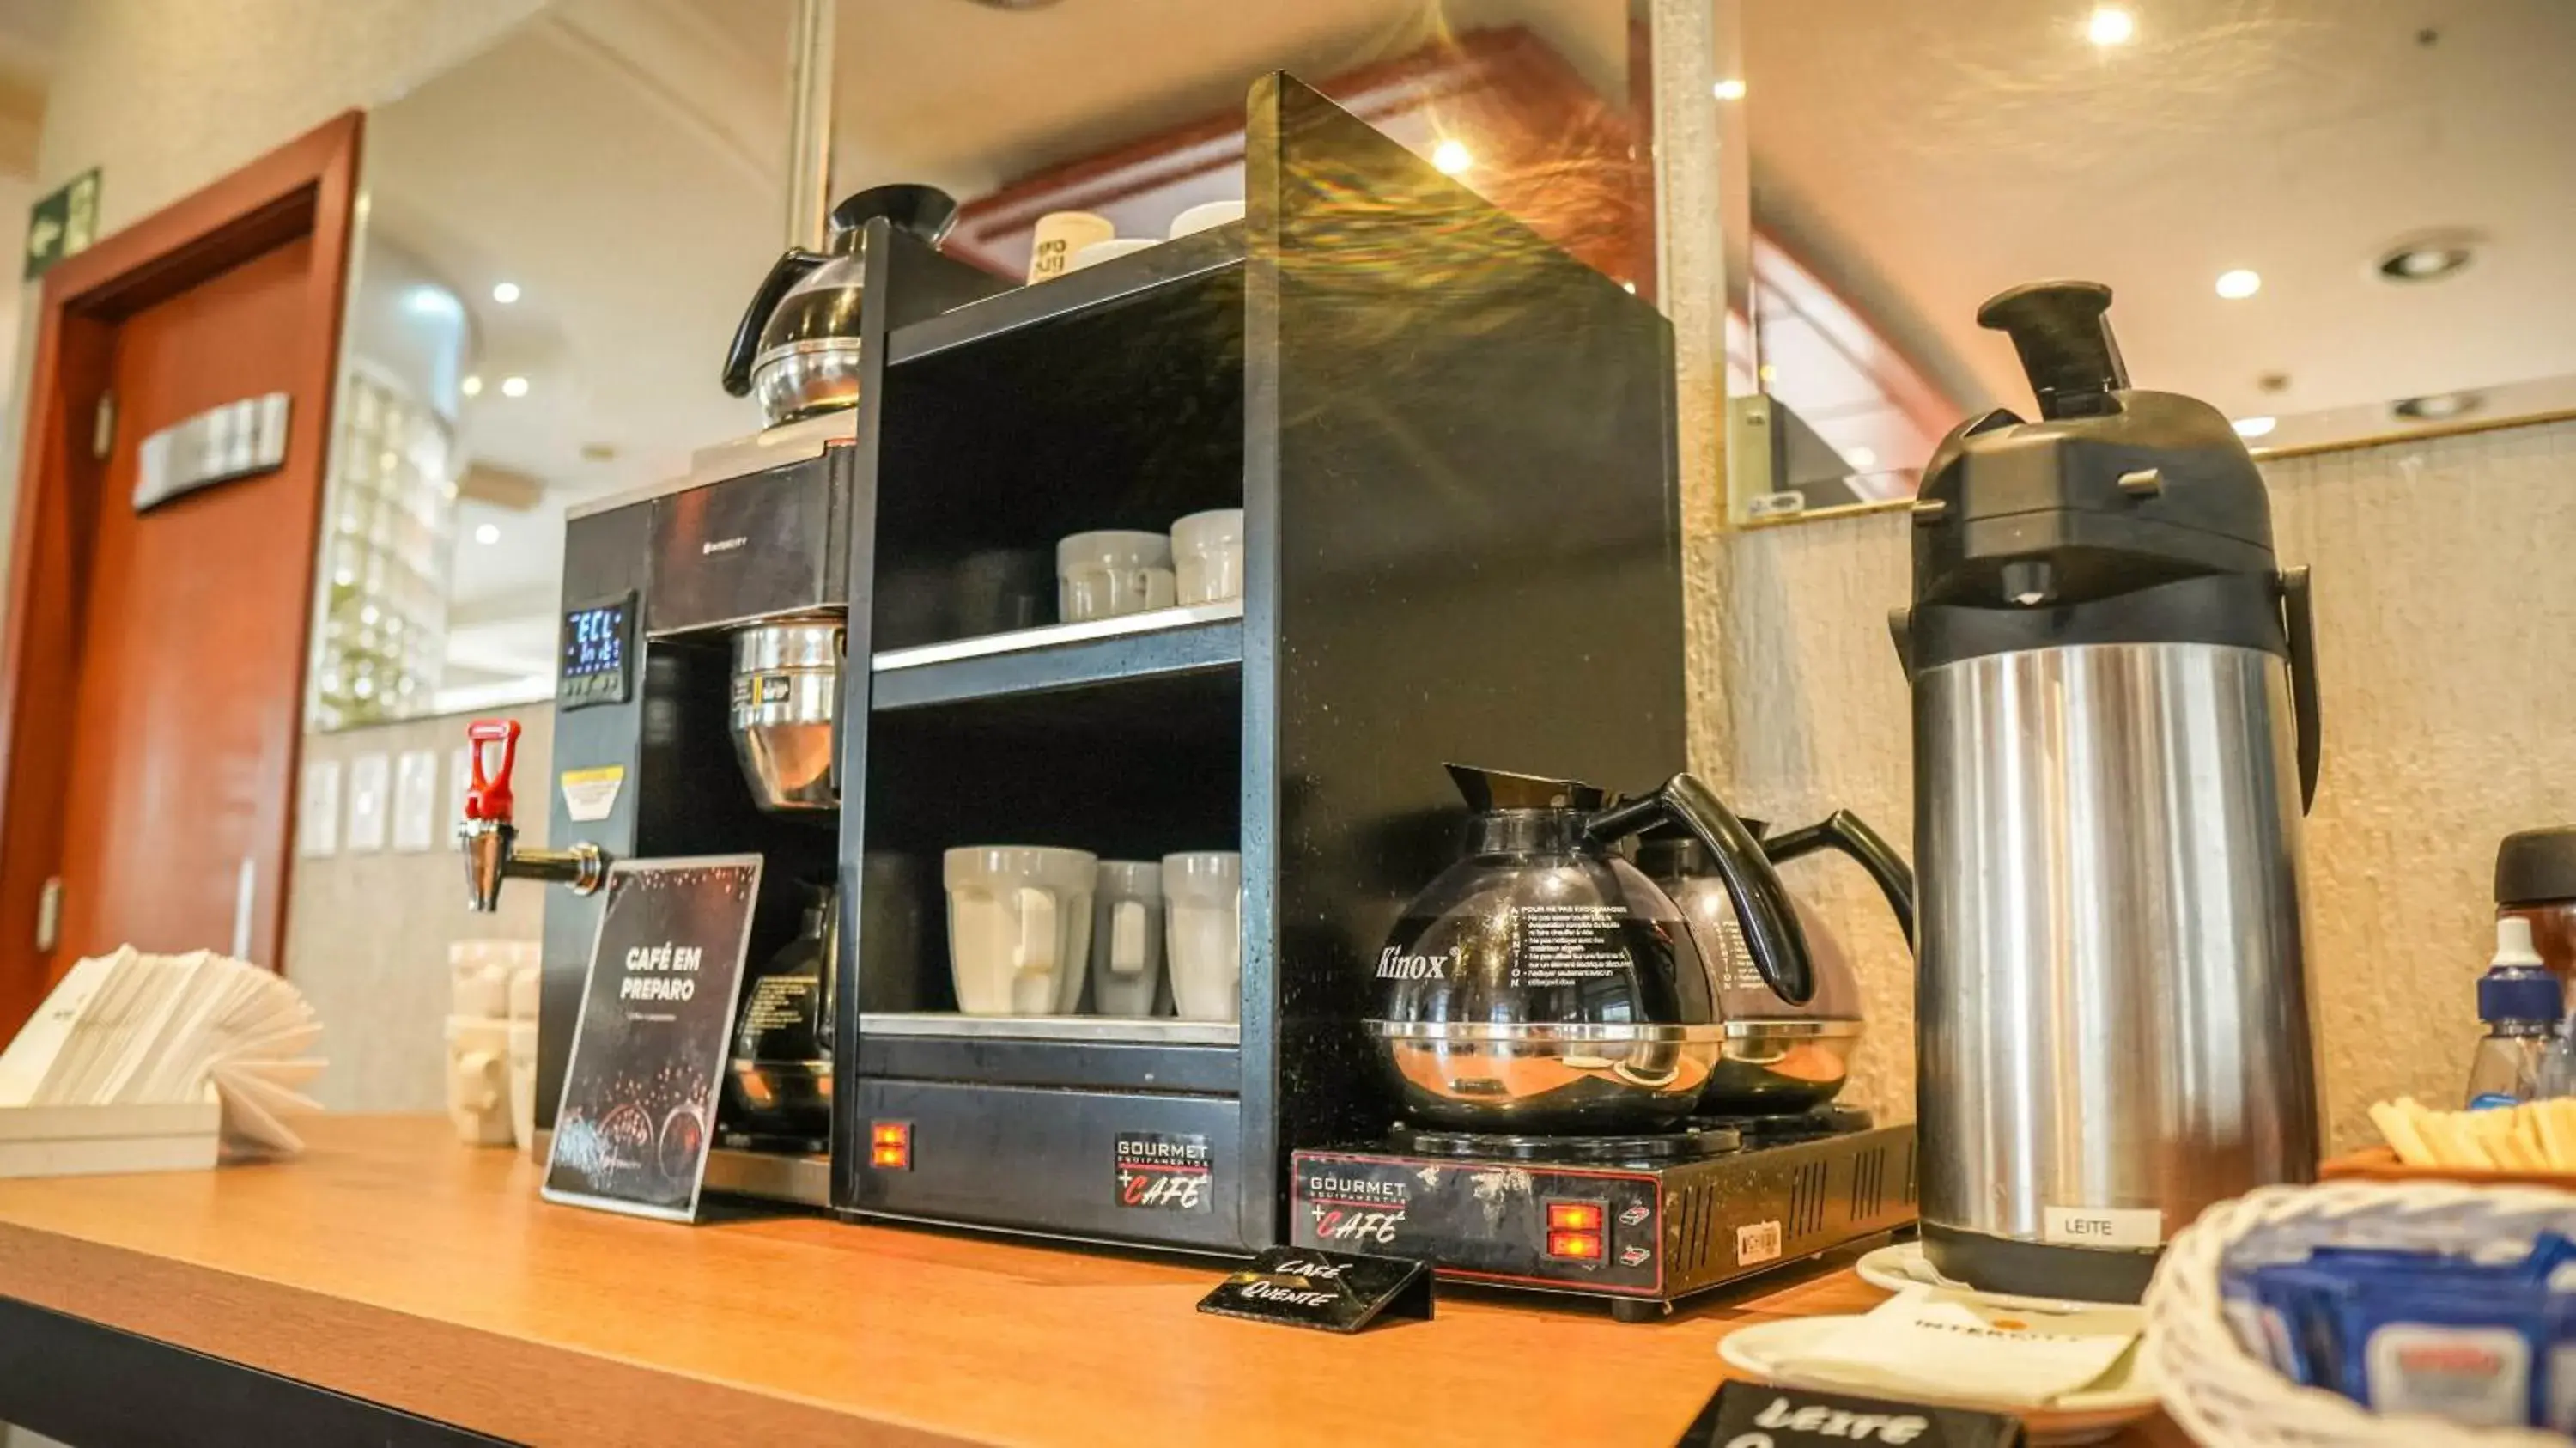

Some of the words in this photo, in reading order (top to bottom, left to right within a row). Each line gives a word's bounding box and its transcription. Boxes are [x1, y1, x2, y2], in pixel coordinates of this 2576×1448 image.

[625, 940, 672, 971] CAFÉ
[672, 946, 702, 971] EM
[619, 976, 695, 1002] PREPARO
[1118, 1141, 1209, 1159] GOURMET
[1310, 1177, 1407, 1196] GOURMET
[2065, 1218, 2113, 1236] LEITE
